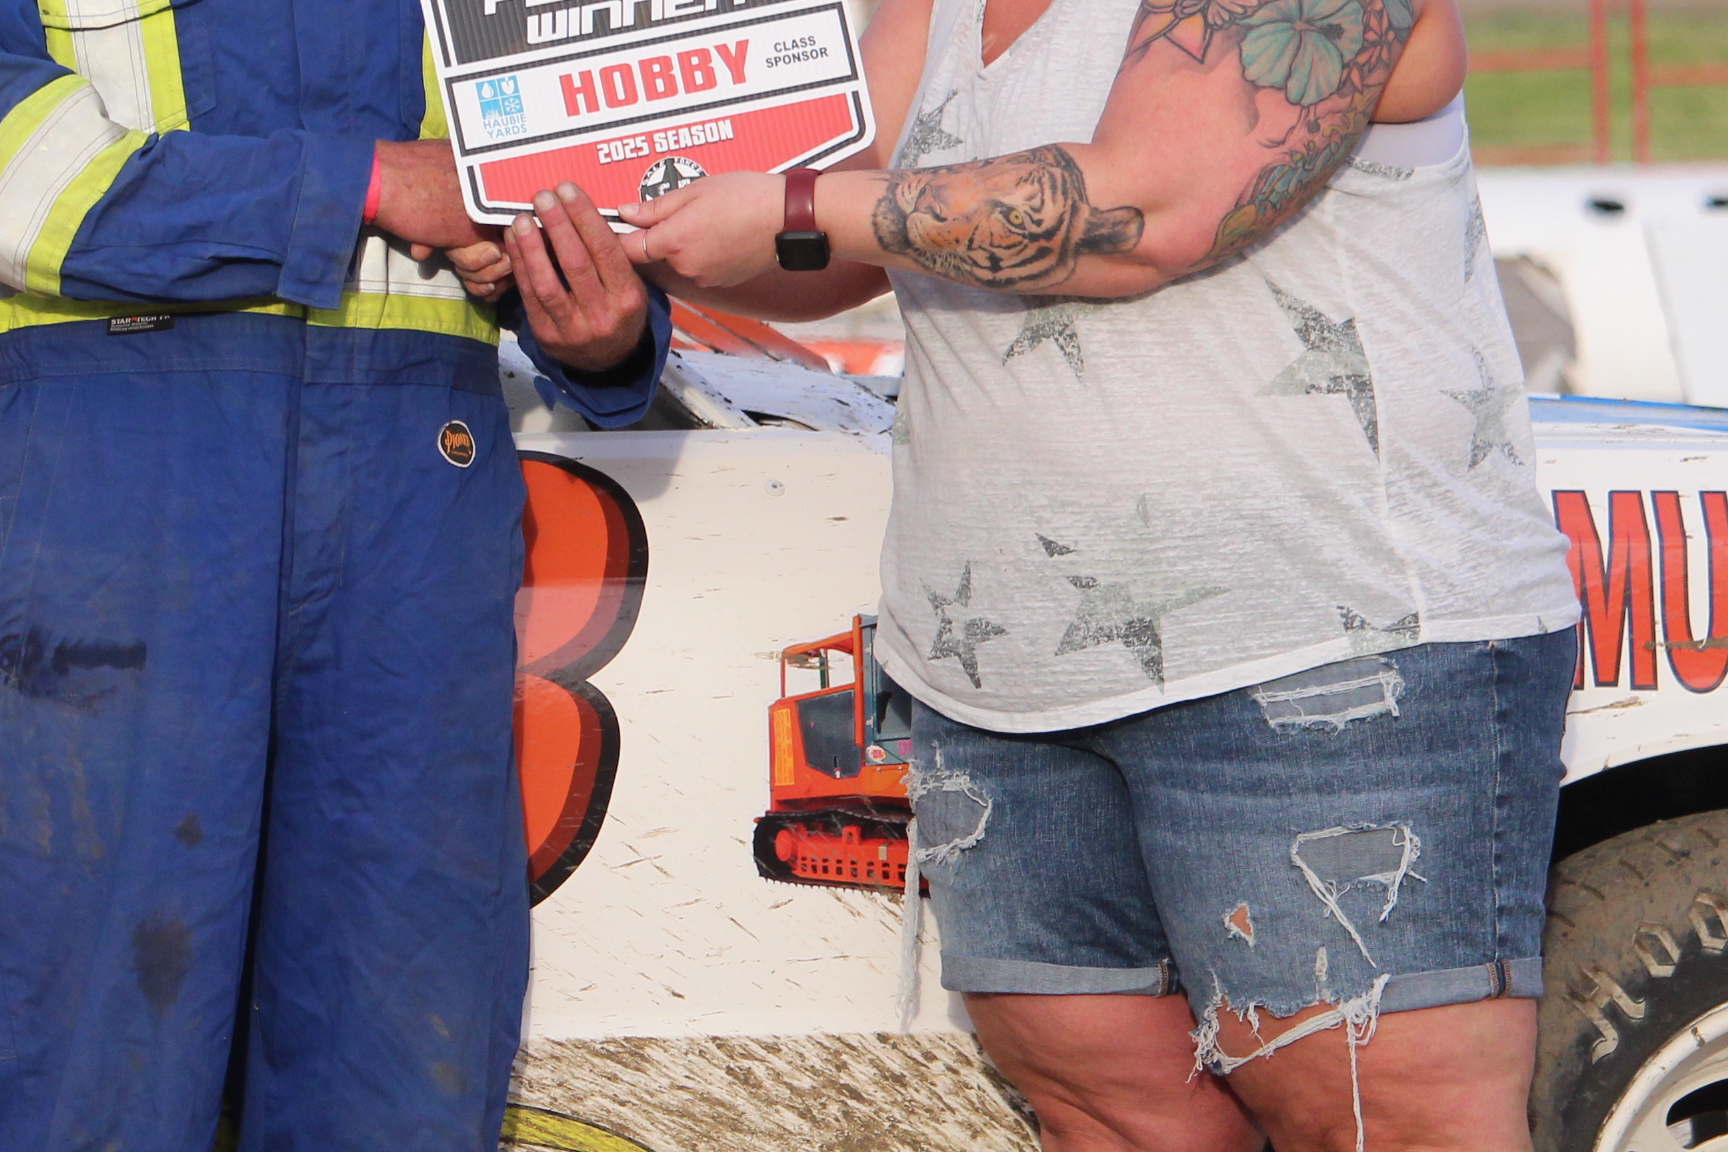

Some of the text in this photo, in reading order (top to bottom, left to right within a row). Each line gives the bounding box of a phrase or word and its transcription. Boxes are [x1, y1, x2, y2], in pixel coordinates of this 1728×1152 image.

[773, 35, 817, 53] CLASS
[765, 47, 830, 69] SPONSOR
[558, 38, 750, 118] HOBBY
[483, 113, 527, 130] HAUBIE
[487, 123, 528, 139] YARDS
[596, 118, 734, 165] 2025 SEASON
